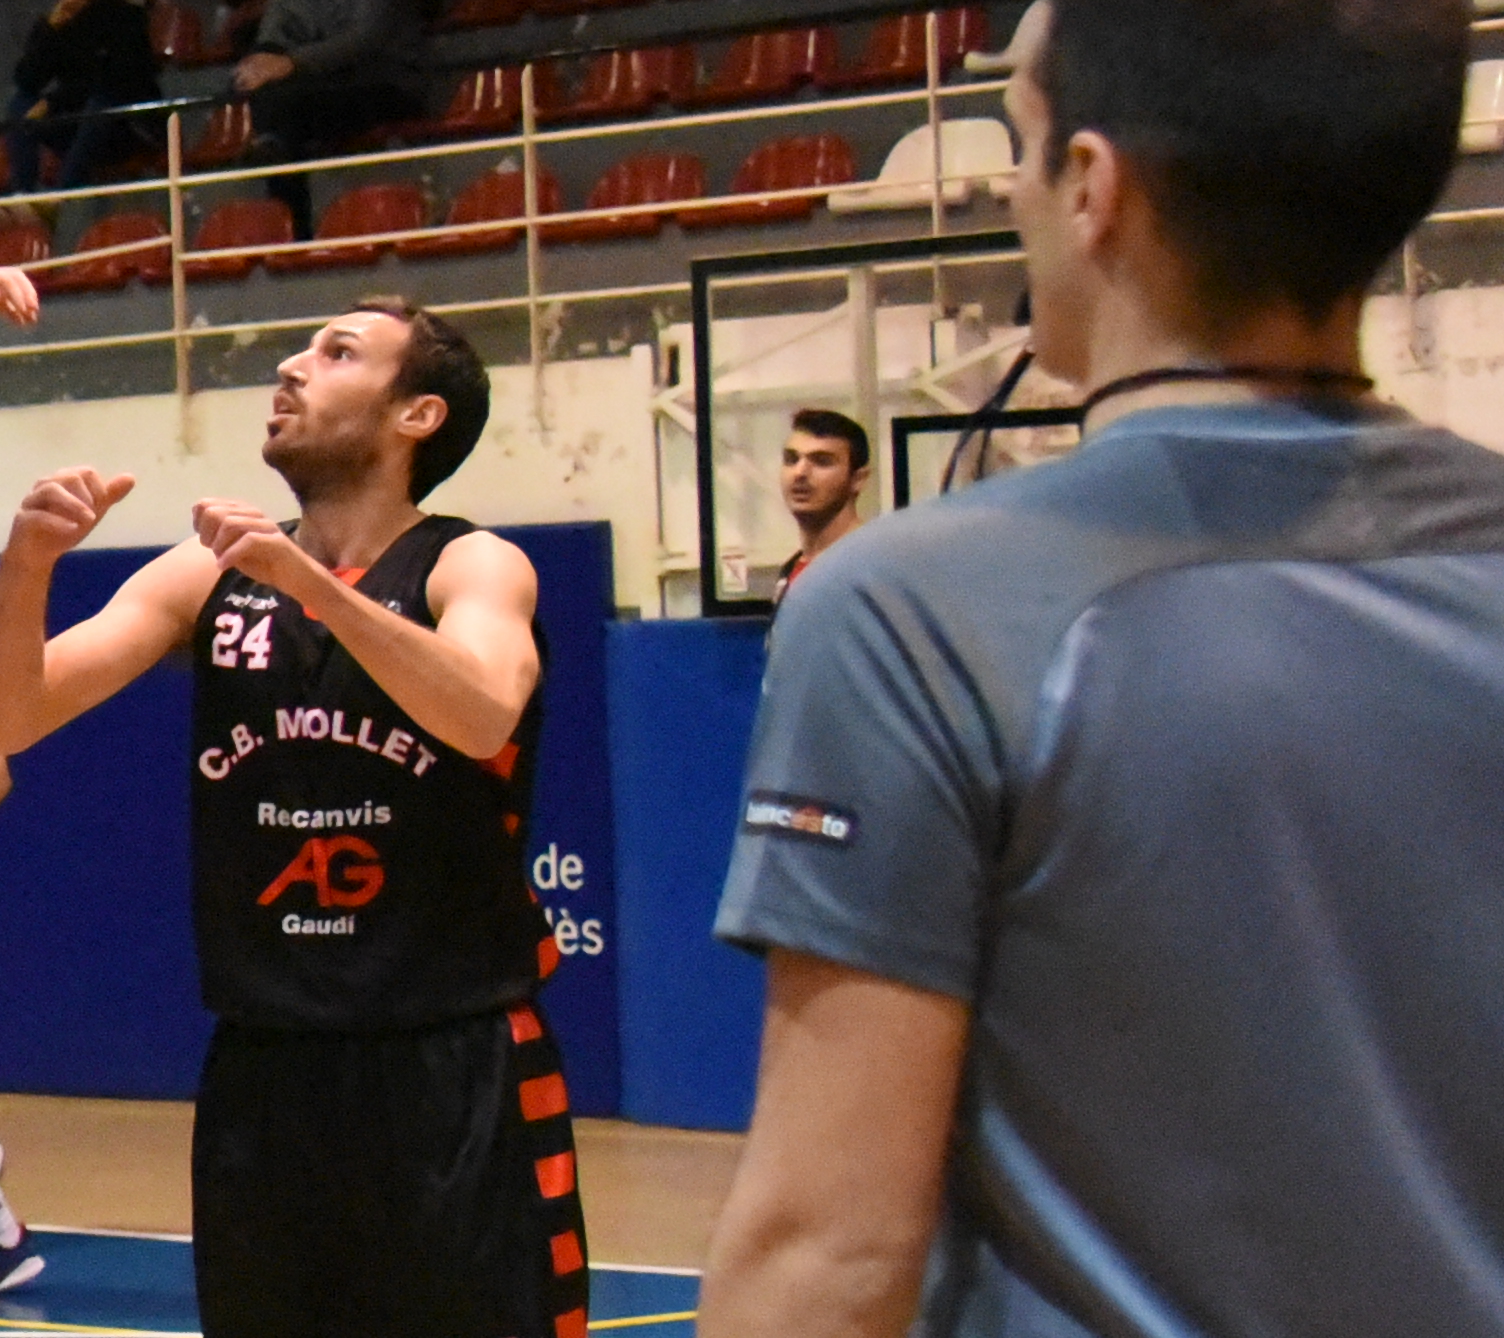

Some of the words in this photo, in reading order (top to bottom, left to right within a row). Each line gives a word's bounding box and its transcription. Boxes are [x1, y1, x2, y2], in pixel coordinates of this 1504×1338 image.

[211, 612, 273, 670] 24
[198, 723, 264, 780] C.B.
[275, 707, 438, 778] MOLLET
[257, 799, 392, 829] Recanvis
[533, 842, 584, 891] de
